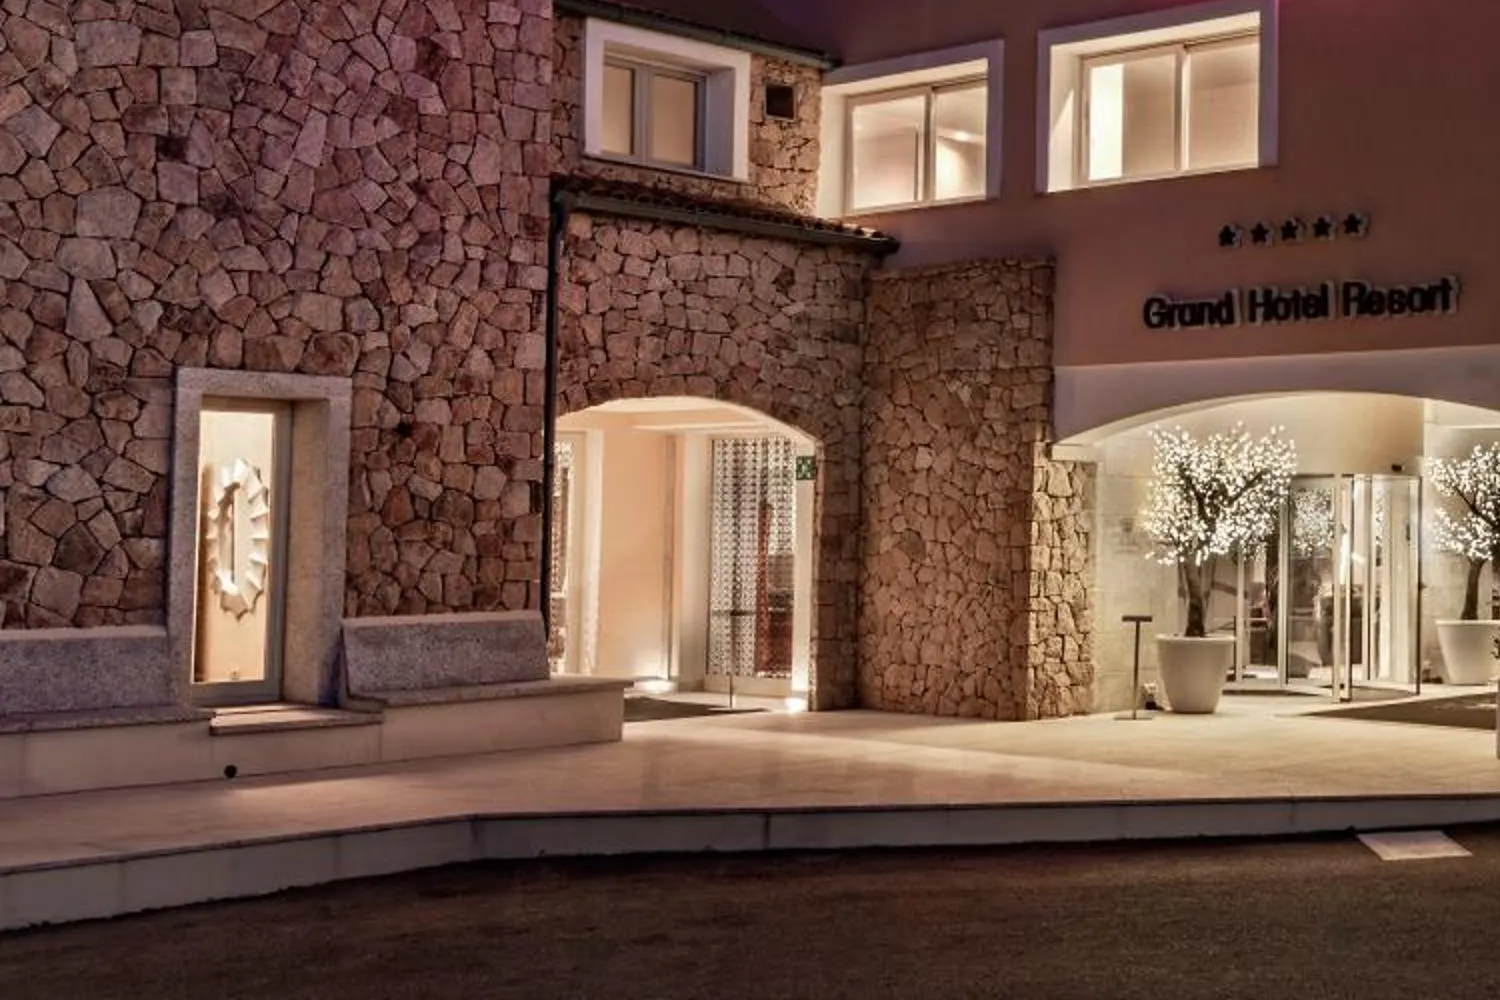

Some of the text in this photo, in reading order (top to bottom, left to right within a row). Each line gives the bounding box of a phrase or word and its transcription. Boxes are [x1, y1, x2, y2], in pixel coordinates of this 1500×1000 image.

[1143, 277, 1454, 330] Grand Hotel Resort
